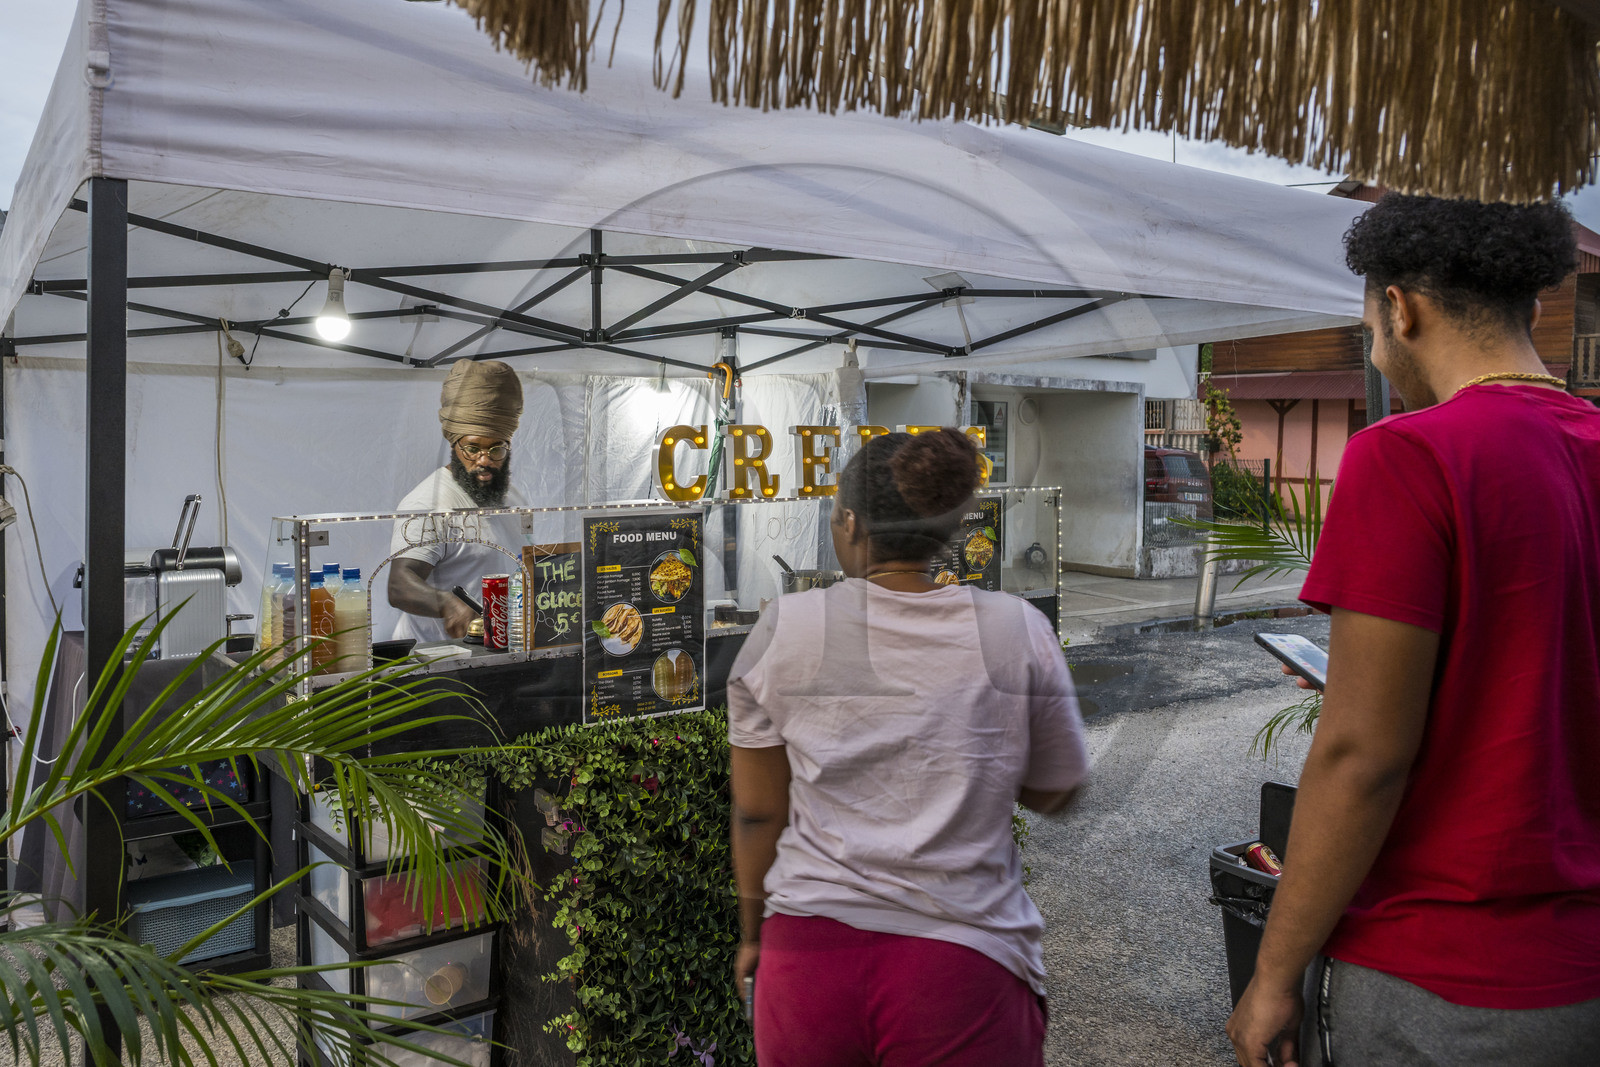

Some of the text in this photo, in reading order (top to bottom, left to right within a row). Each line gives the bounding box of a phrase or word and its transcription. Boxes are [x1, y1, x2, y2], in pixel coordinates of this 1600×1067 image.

[613, 531, 677, 544] FOOD MENU
[535, 554, 576, 582] THÉ
